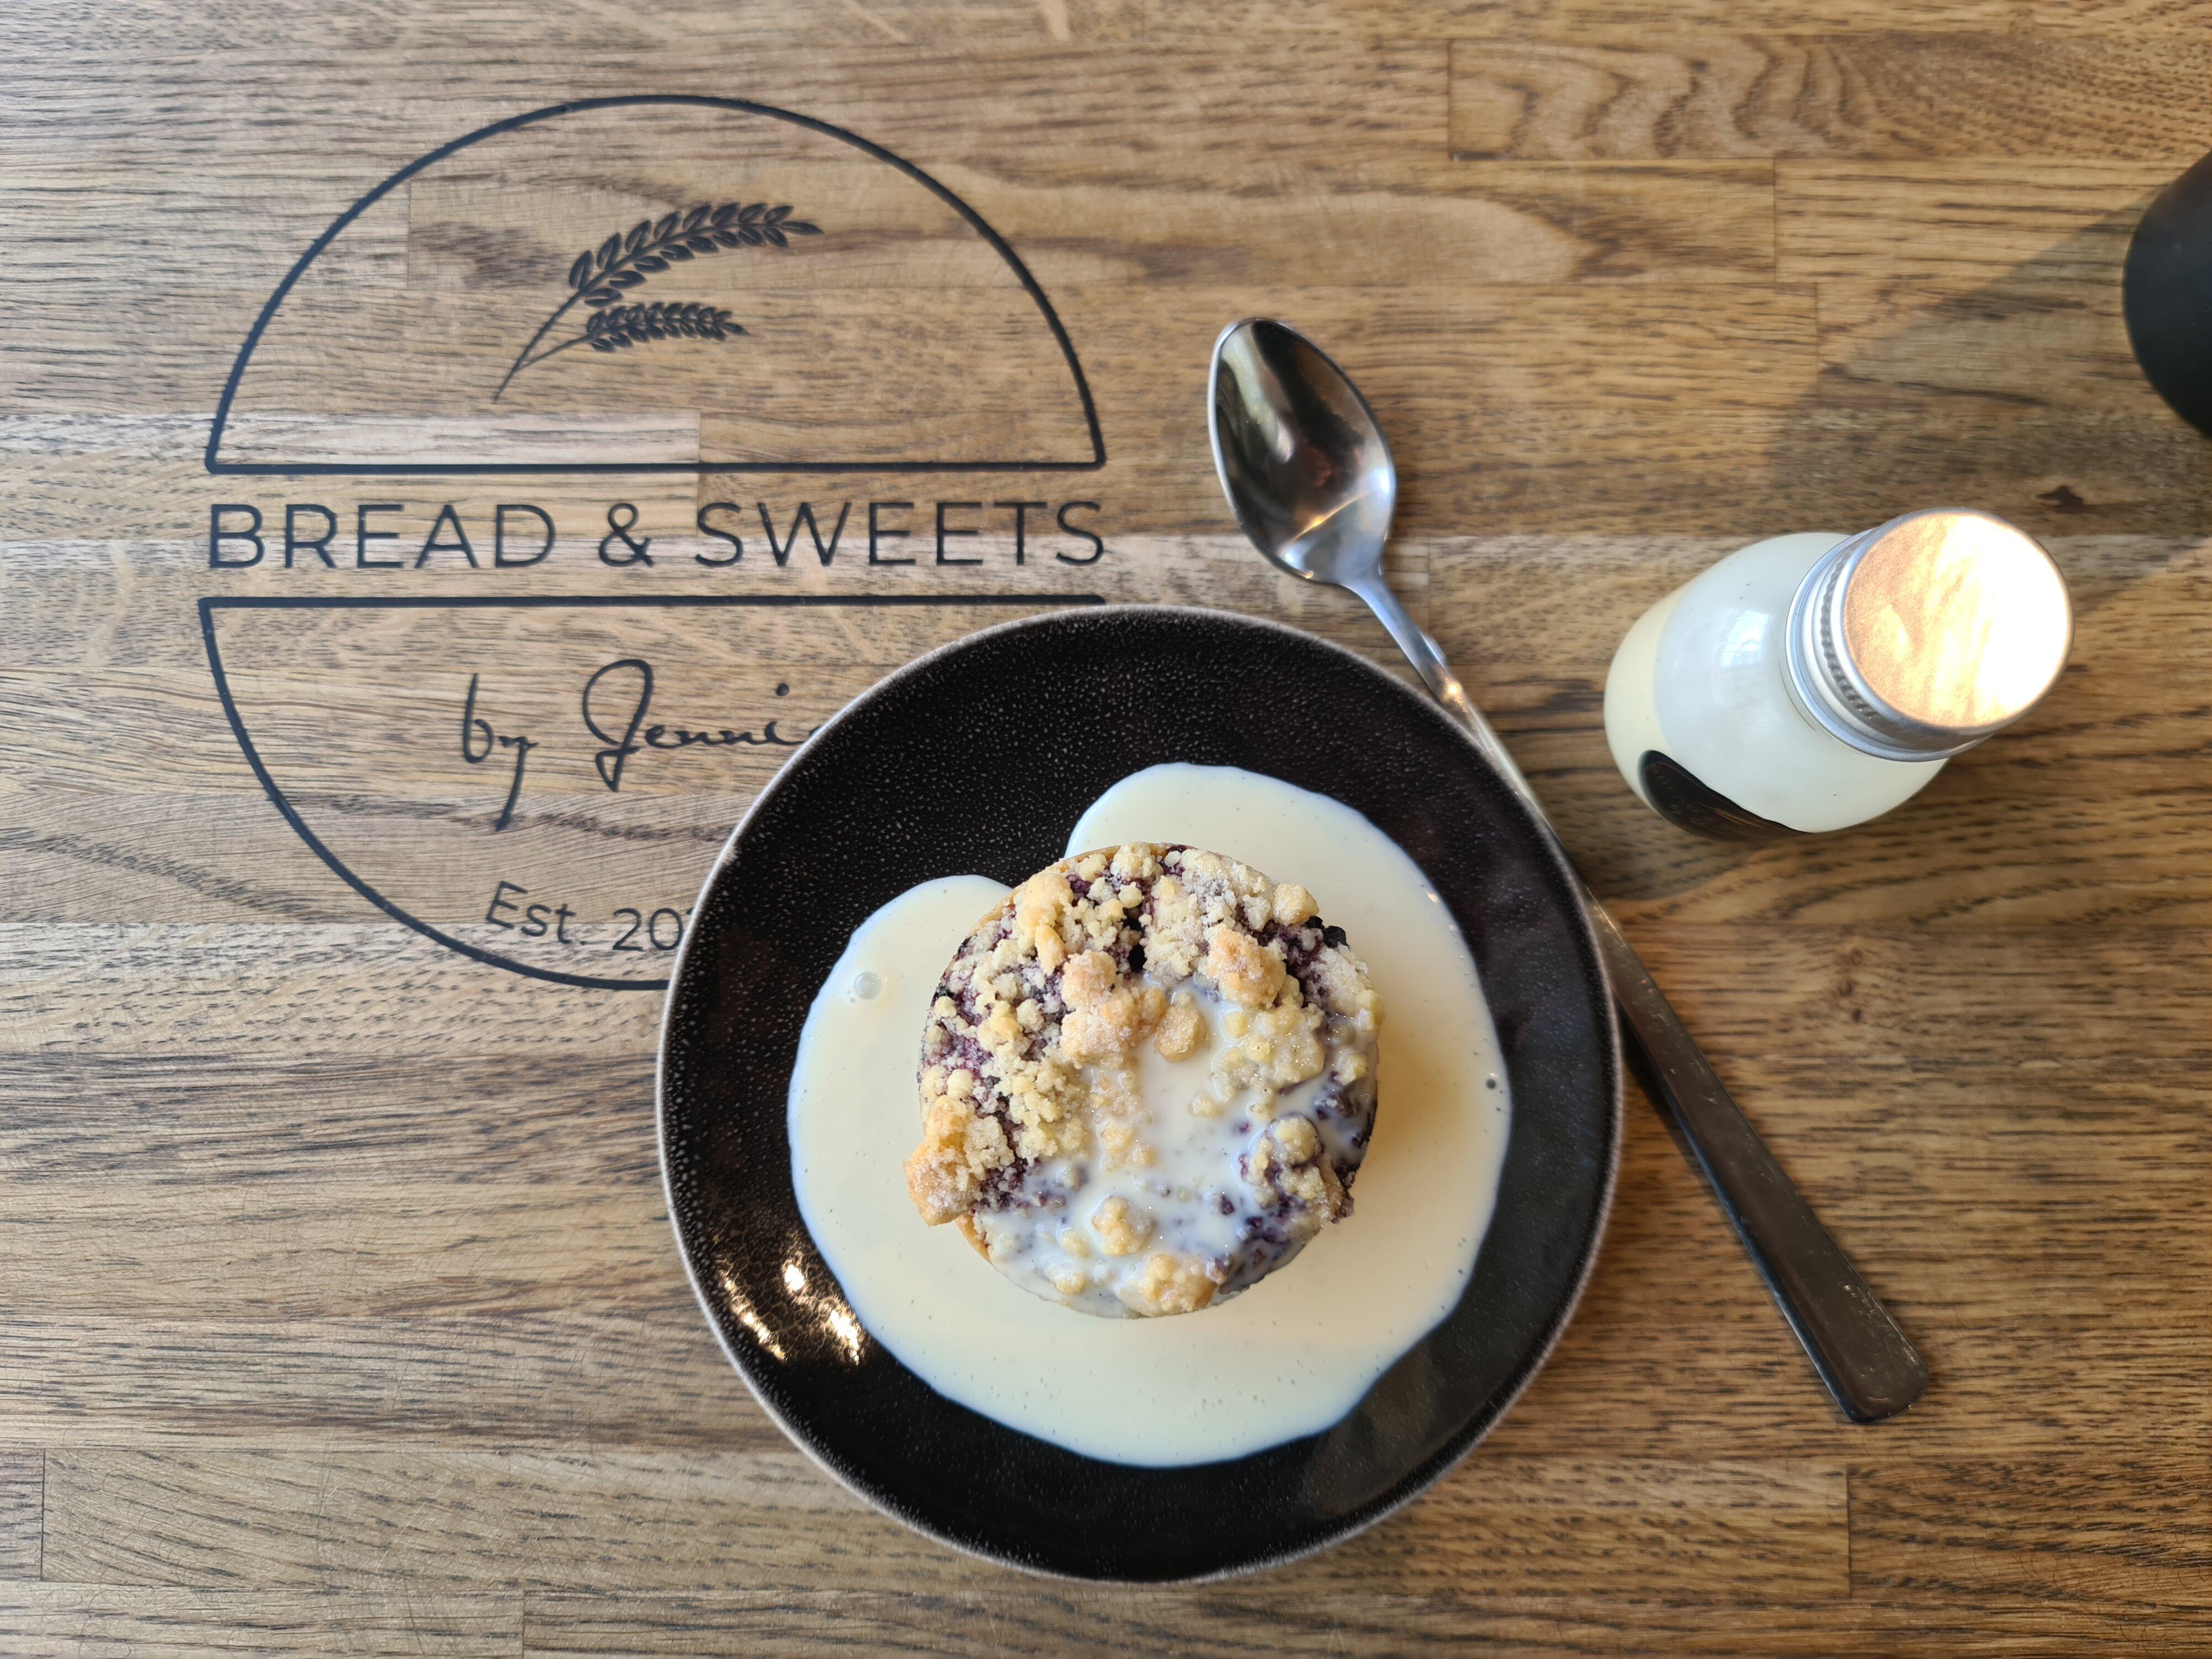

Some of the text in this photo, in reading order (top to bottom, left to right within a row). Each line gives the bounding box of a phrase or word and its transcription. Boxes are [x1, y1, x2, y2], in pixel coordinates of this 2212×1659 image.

[210, 500, 1105, 568] BREAD & SWEETS
[462, 658, 823, 831] by Jenni
[486, 880, 695, 951] Est. 20
